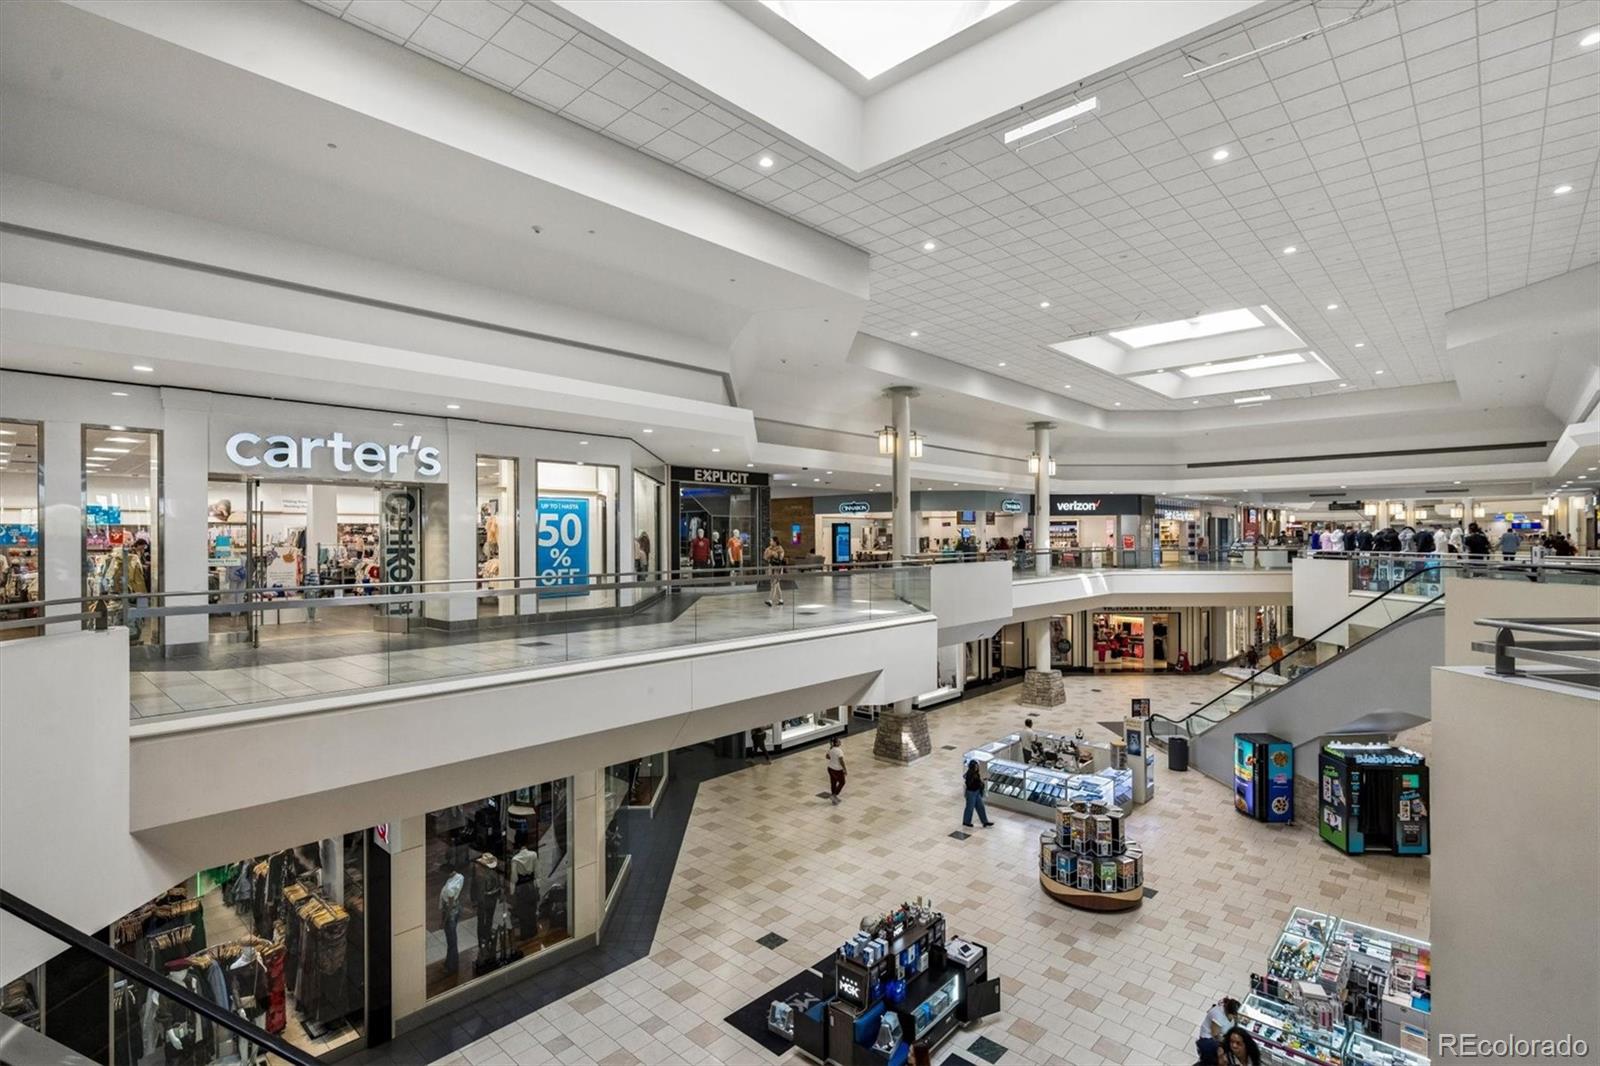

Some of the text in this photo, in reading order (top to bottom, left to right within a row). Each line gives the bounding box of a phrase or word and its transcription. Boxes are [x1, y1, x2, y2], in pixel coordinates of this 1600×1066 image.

[225, 431, 442, 476] carter's
[694, 469, 749, 484] EXPLICIT
[1056, 500, 1096, 511] verizon
[538, 512, 582, 547] 50
[550, 548, 571, 567] %
[541, 568, 580, 586] OFF
